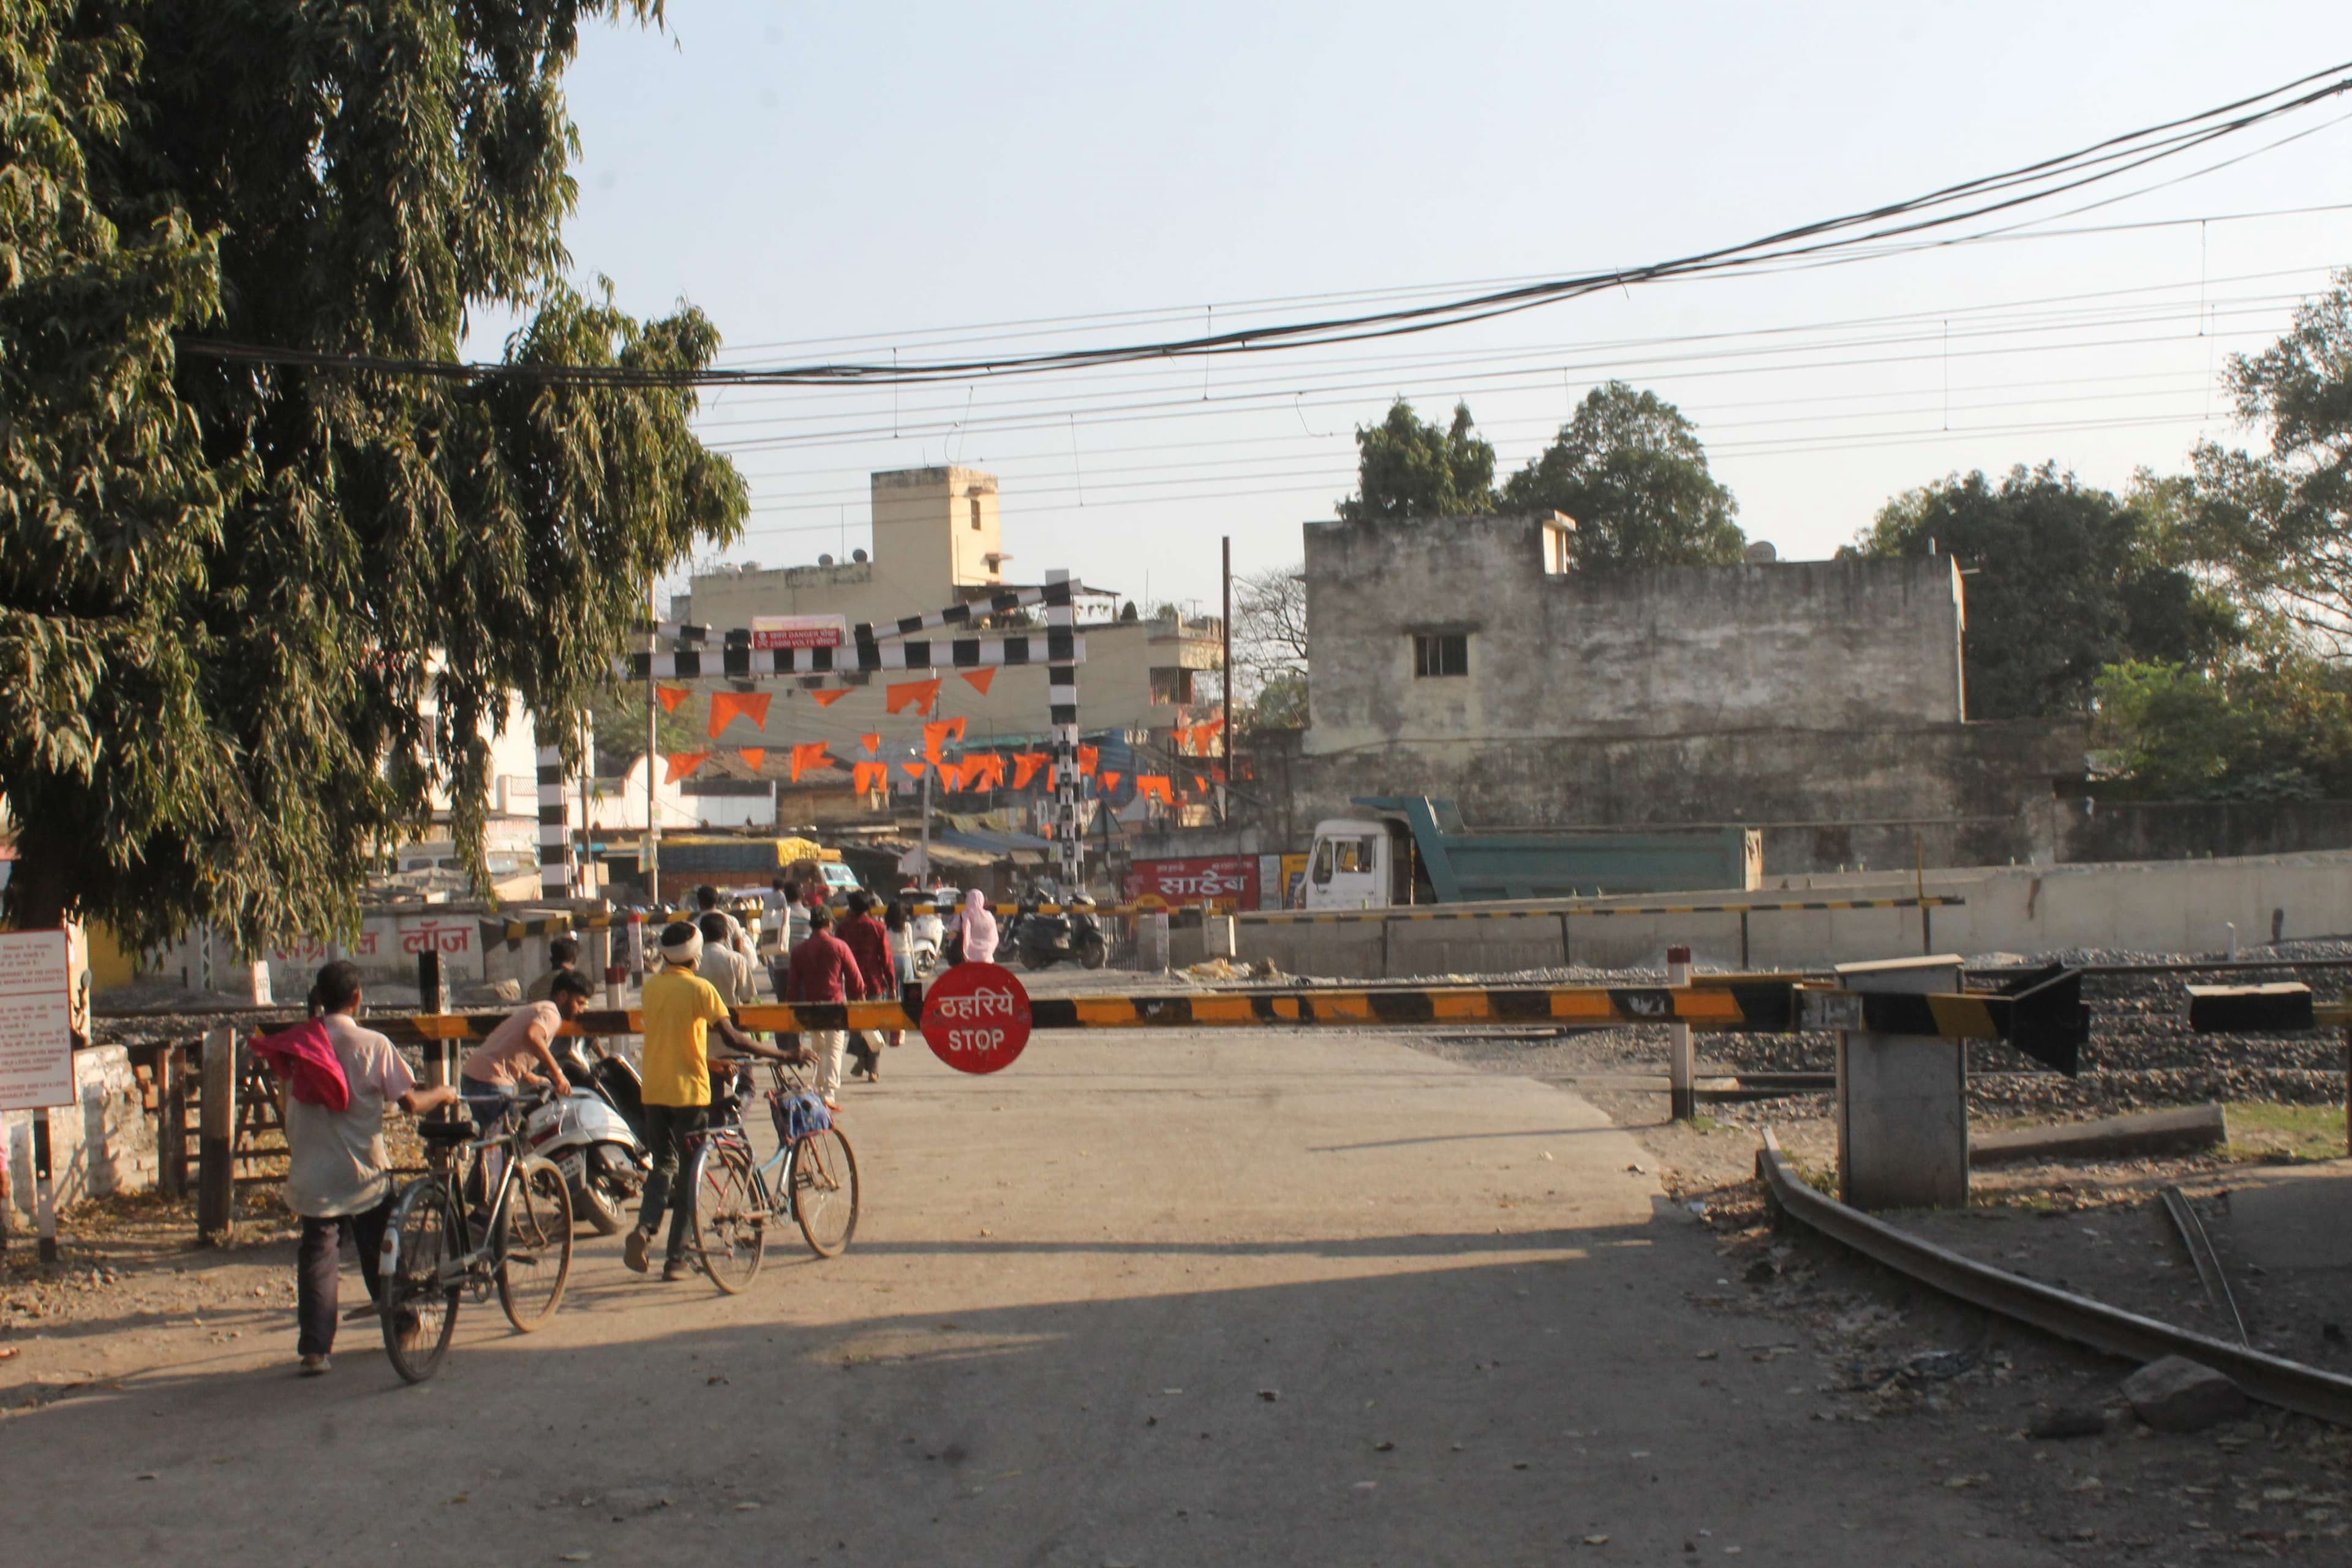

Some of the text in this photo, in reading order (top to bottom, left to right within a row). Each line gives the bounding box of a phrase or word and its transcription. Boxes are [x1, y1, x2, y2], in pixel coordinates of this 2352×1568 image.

[789, 630, 818, 638] DANGER
[1158, 870, 1248, 895] साहेब
[399, 920, 473, 955] लॉज
[938, 986, 1014, 1019] ठहरिये
[949, 1028, 1005, 1051] STOP
